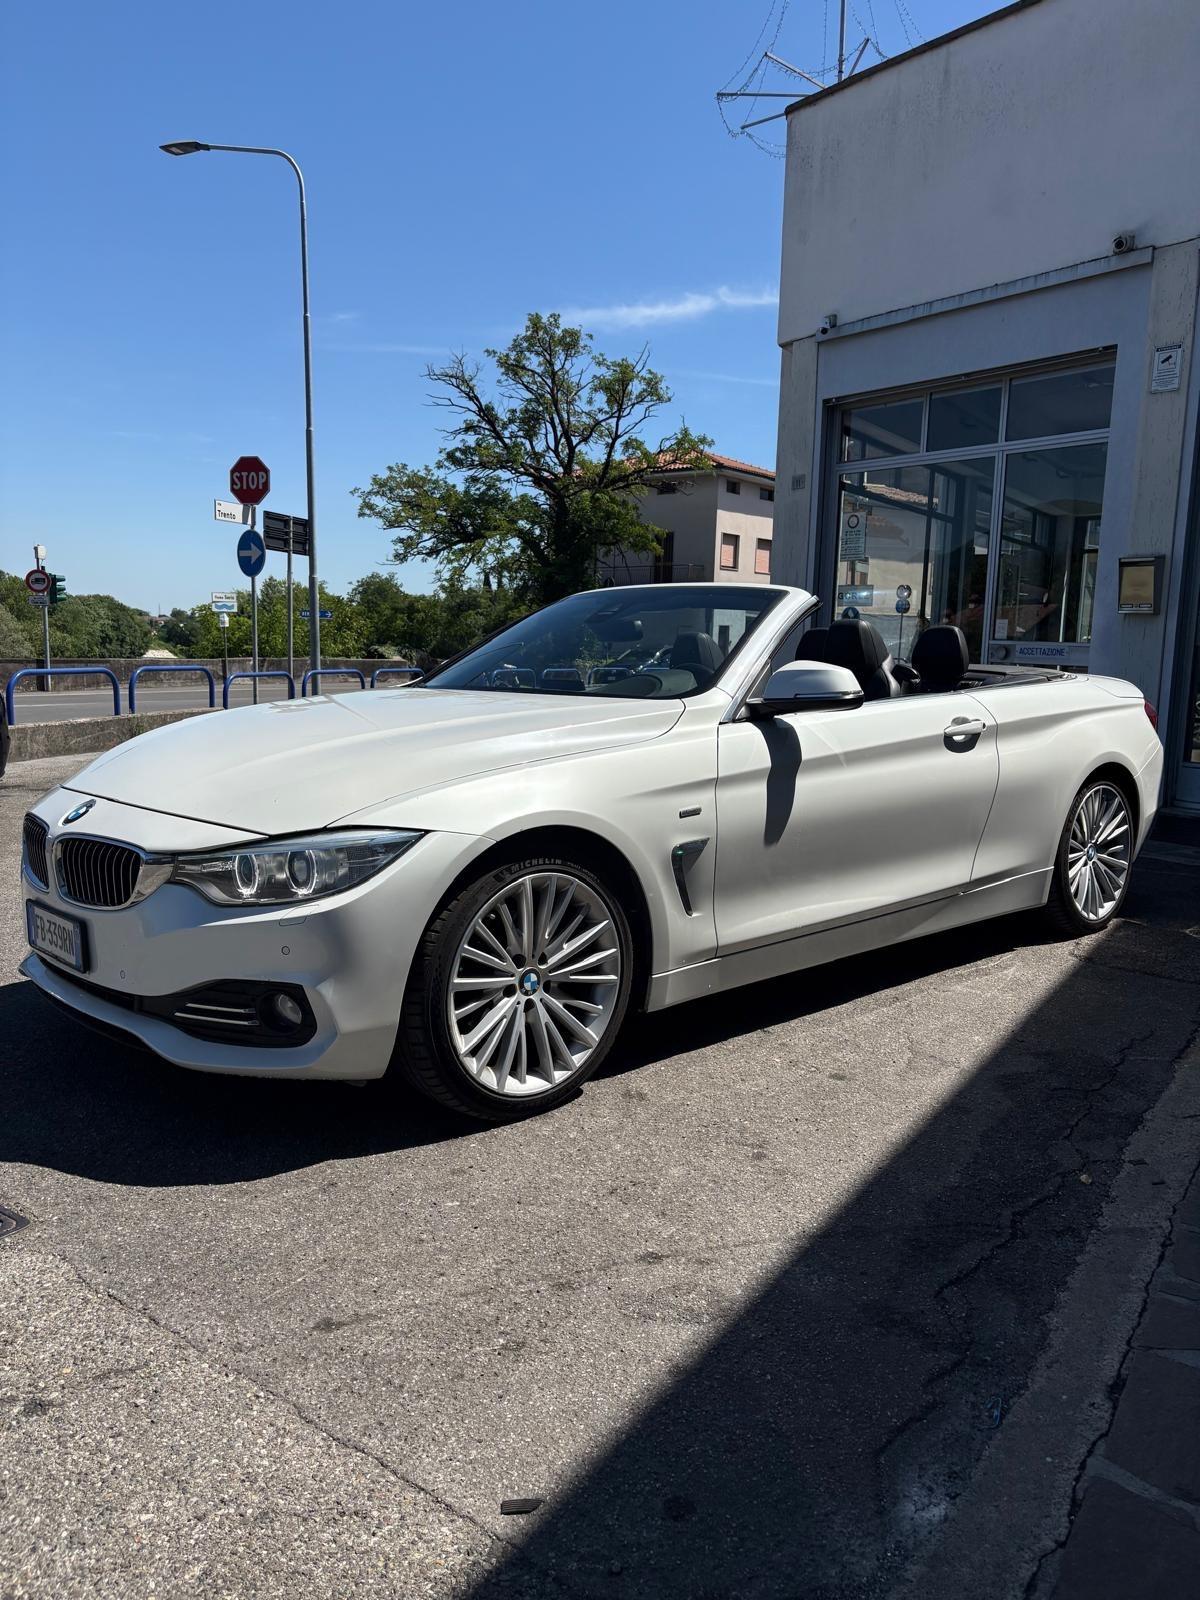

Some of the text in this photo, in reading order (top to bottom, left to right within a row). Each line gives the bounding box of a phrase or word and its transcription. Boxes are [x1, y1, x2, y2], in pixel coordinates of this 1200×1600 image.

[233, 471, 267, 490] STOP
[217, 509, 236, 520] Trento
[1019, 647, 1065, 657] ACCETTAZIONE
[511, 857, 562, 873] MICHELIN
